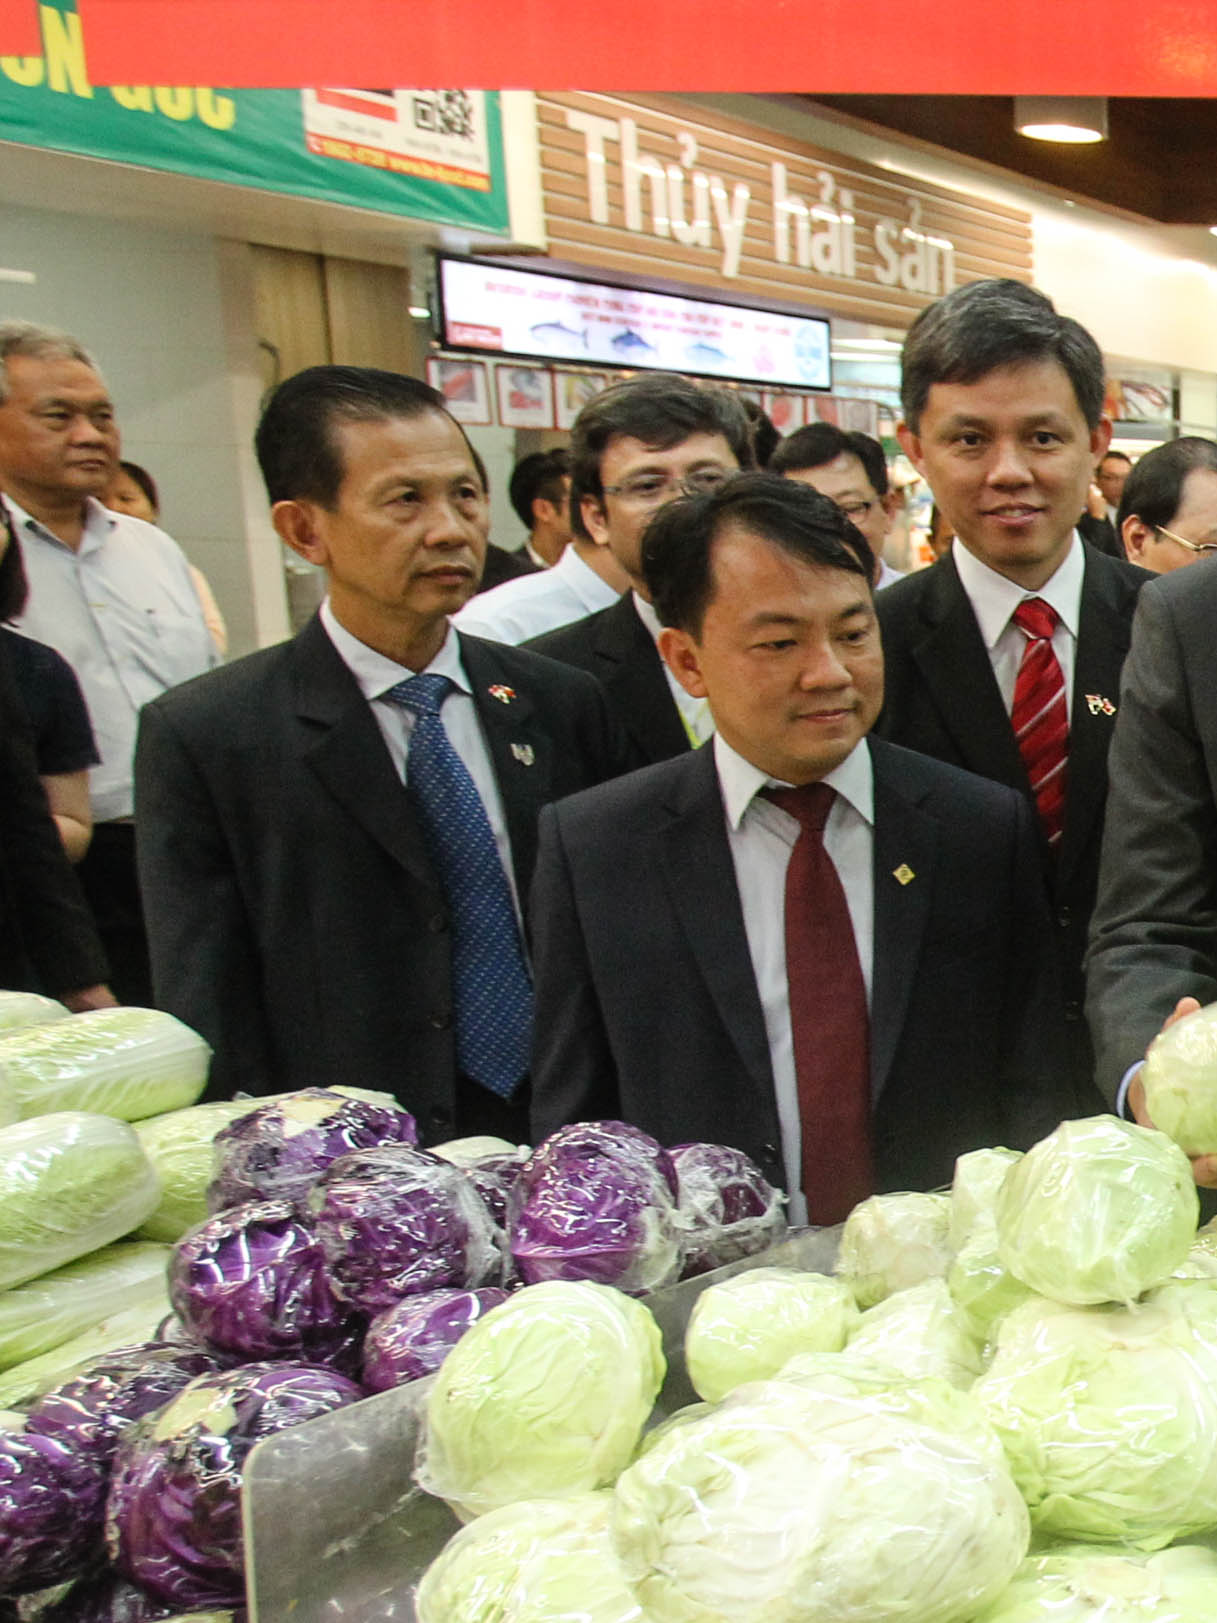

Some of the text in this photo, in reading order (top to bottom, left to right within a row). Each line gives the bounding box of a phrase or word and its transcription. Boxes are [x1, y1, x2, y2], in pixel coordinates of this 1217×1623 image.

[566, 109, 751, 278] Thủy
[772, 160, 856, 278] hải
[874, 197, 955, 295] sản
